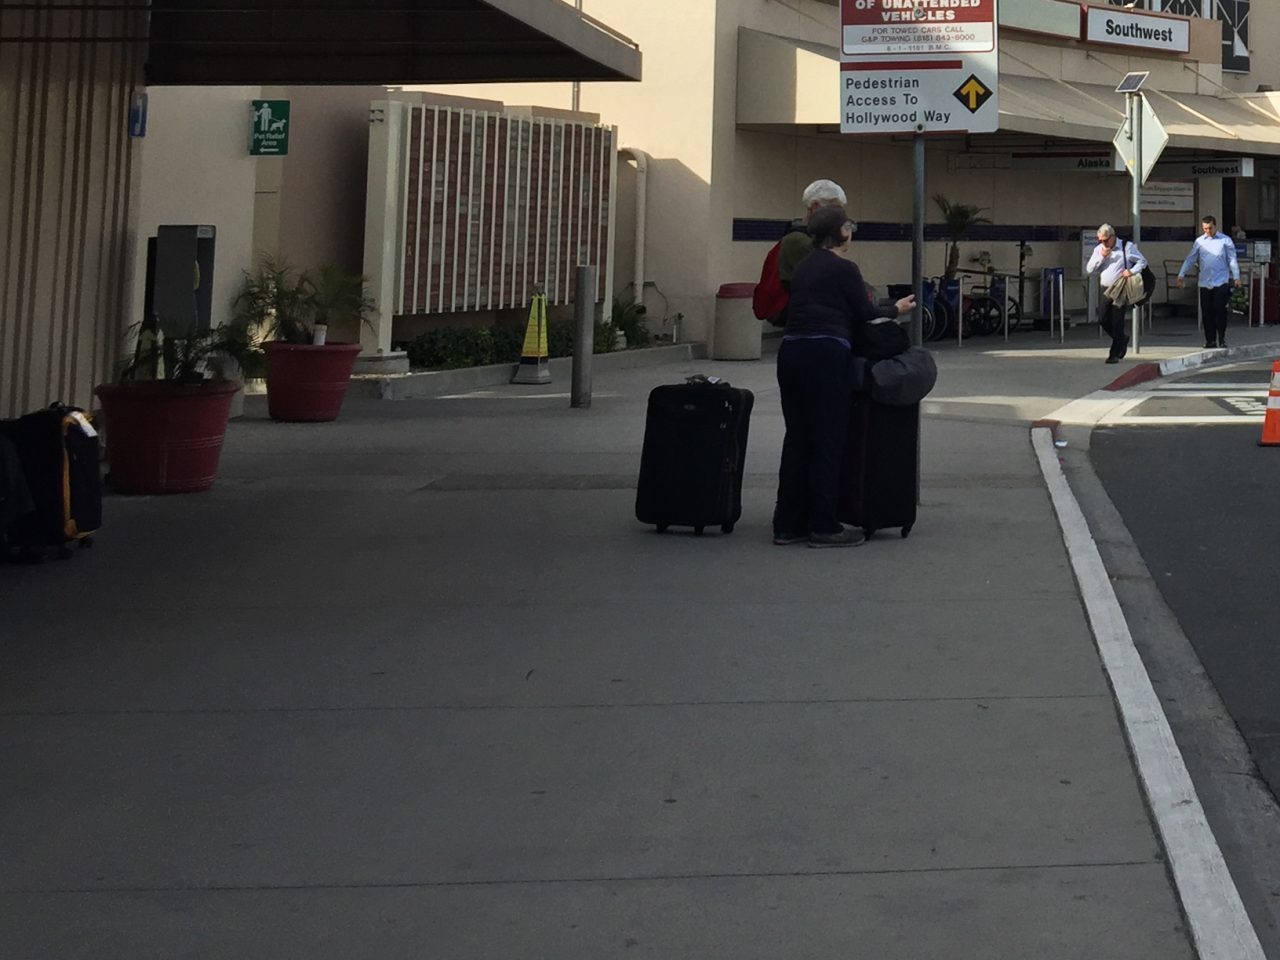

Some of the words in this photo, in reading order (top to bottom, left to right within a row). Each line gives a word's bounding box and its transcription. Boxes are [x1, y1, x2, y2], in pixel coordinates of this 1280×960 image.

[855, 0, 876, 10] OF
[1105, 19, 1173, 42] Southwest
[846, 77, 920, 90] Pedestrian
[846, 94, 896, 107] Access
[903, 93, 918, 105] To
[846, 112, 917, 126] Hollywood
[924, 110, 951, 125] Way
[1077, 158, 1110, 168] Alaska
[1192, 165, 1239, 175] Southwest
